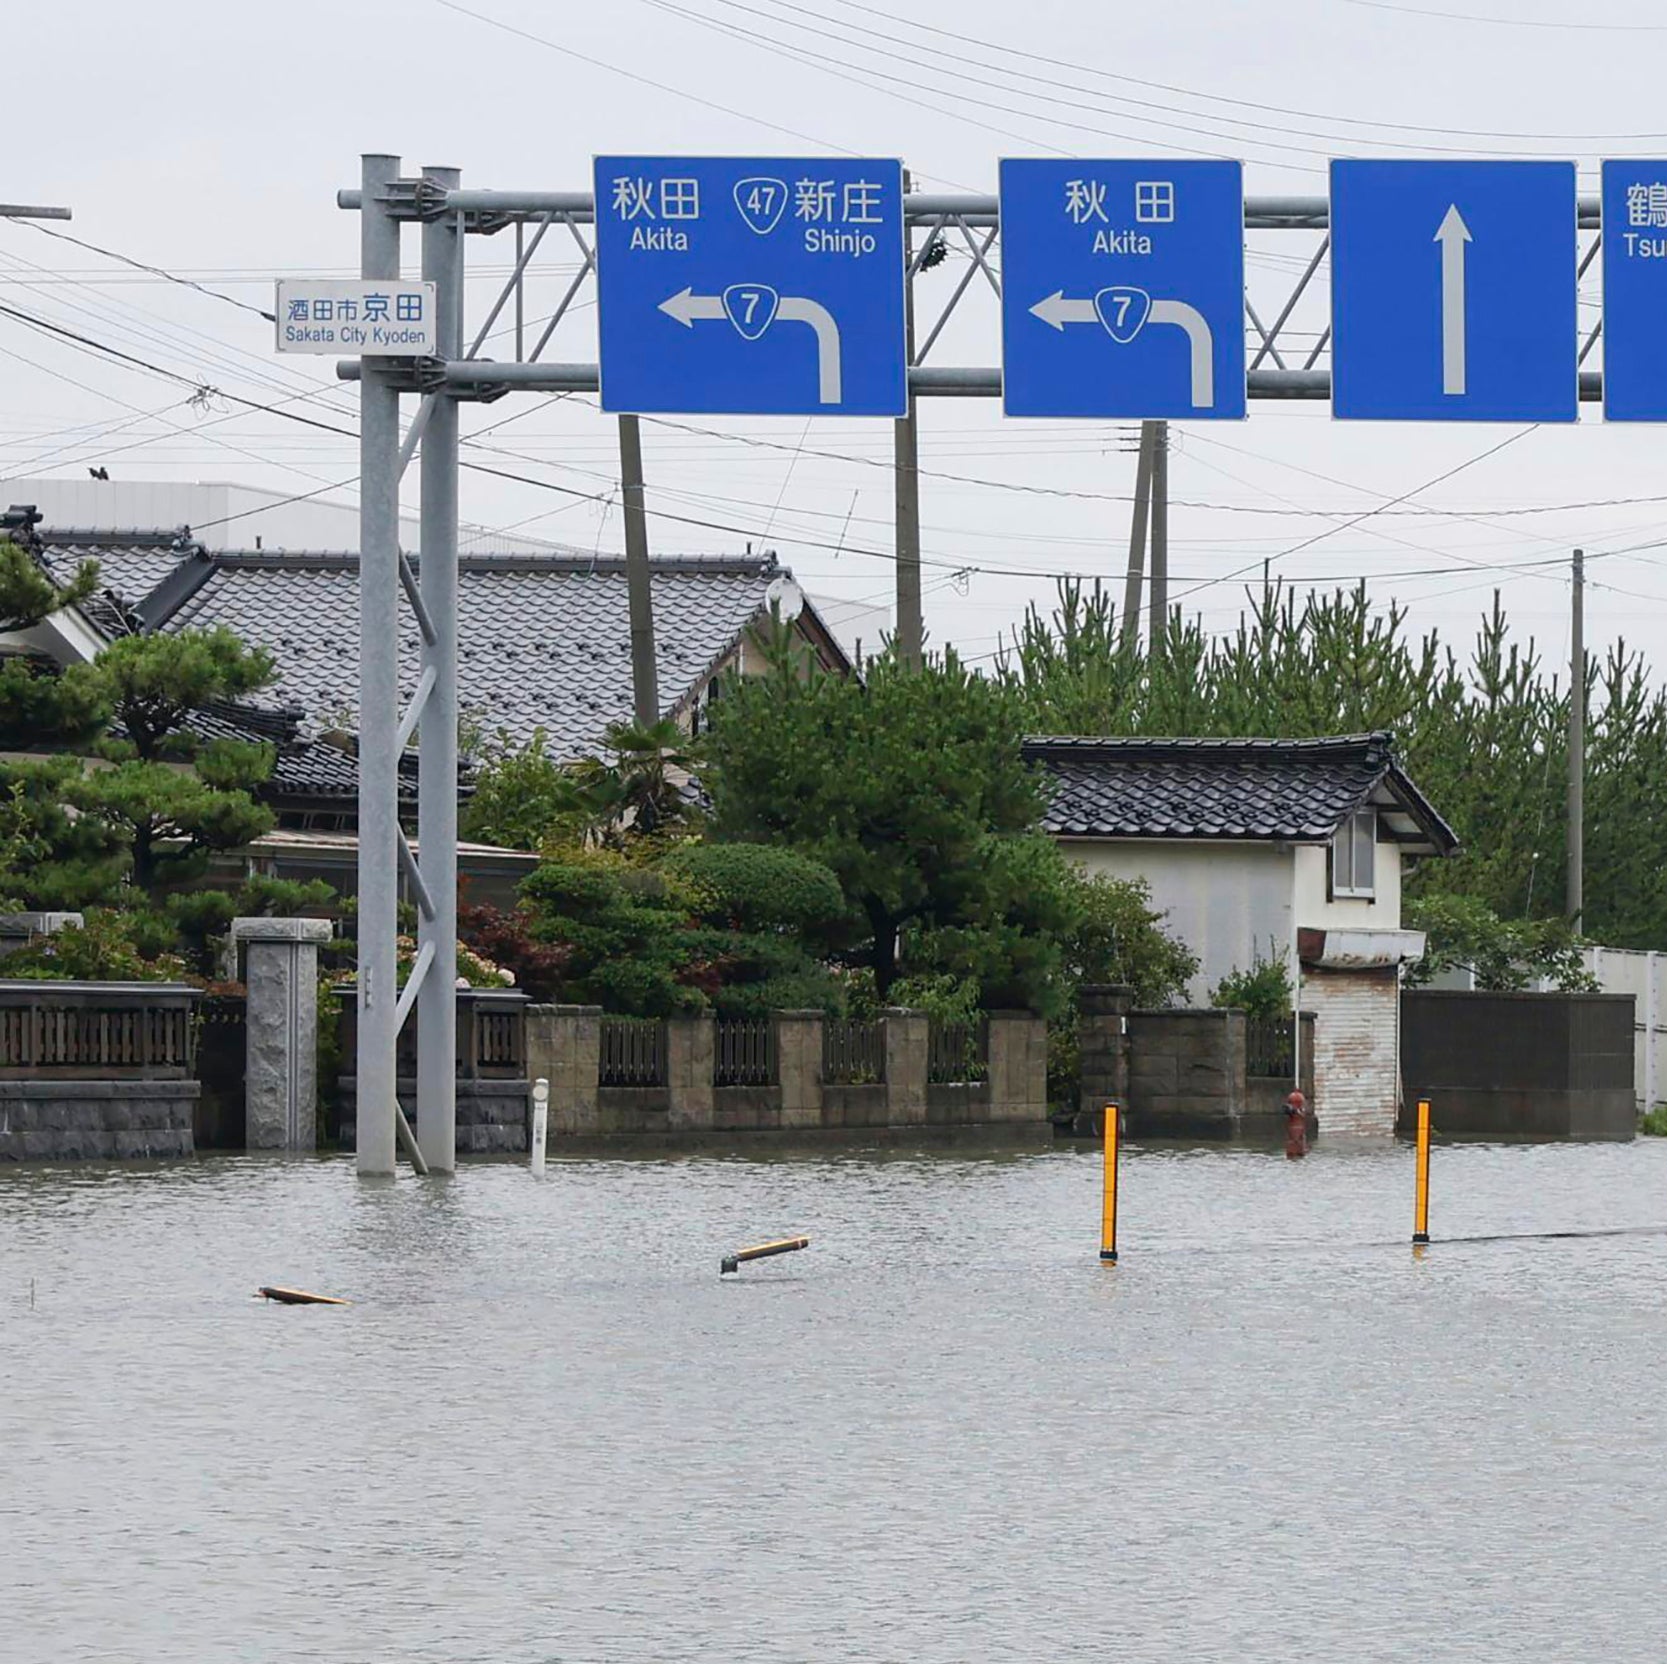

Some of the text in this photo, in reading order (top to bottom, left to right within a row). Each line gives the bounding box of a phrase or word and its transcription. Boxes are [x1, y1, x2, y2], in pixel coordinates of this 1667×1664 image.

[612, 176, 699, 220] 秋田
[747, 178, 883, 223] 47 新庄
[1065, 180, 1174, 224] 秋田
[630, 227, 688, 251] Akita
[805, 229, 876, 257] Shinjo
[1092, 230, 1151, 254] Akita
[288, 293, 422, 322] 酒田市京田
[741, 293, 760, 324] 7
[1113, 296, 1131, 327] 7
[286, 326, 425, 346] Sakata City Kyoden
